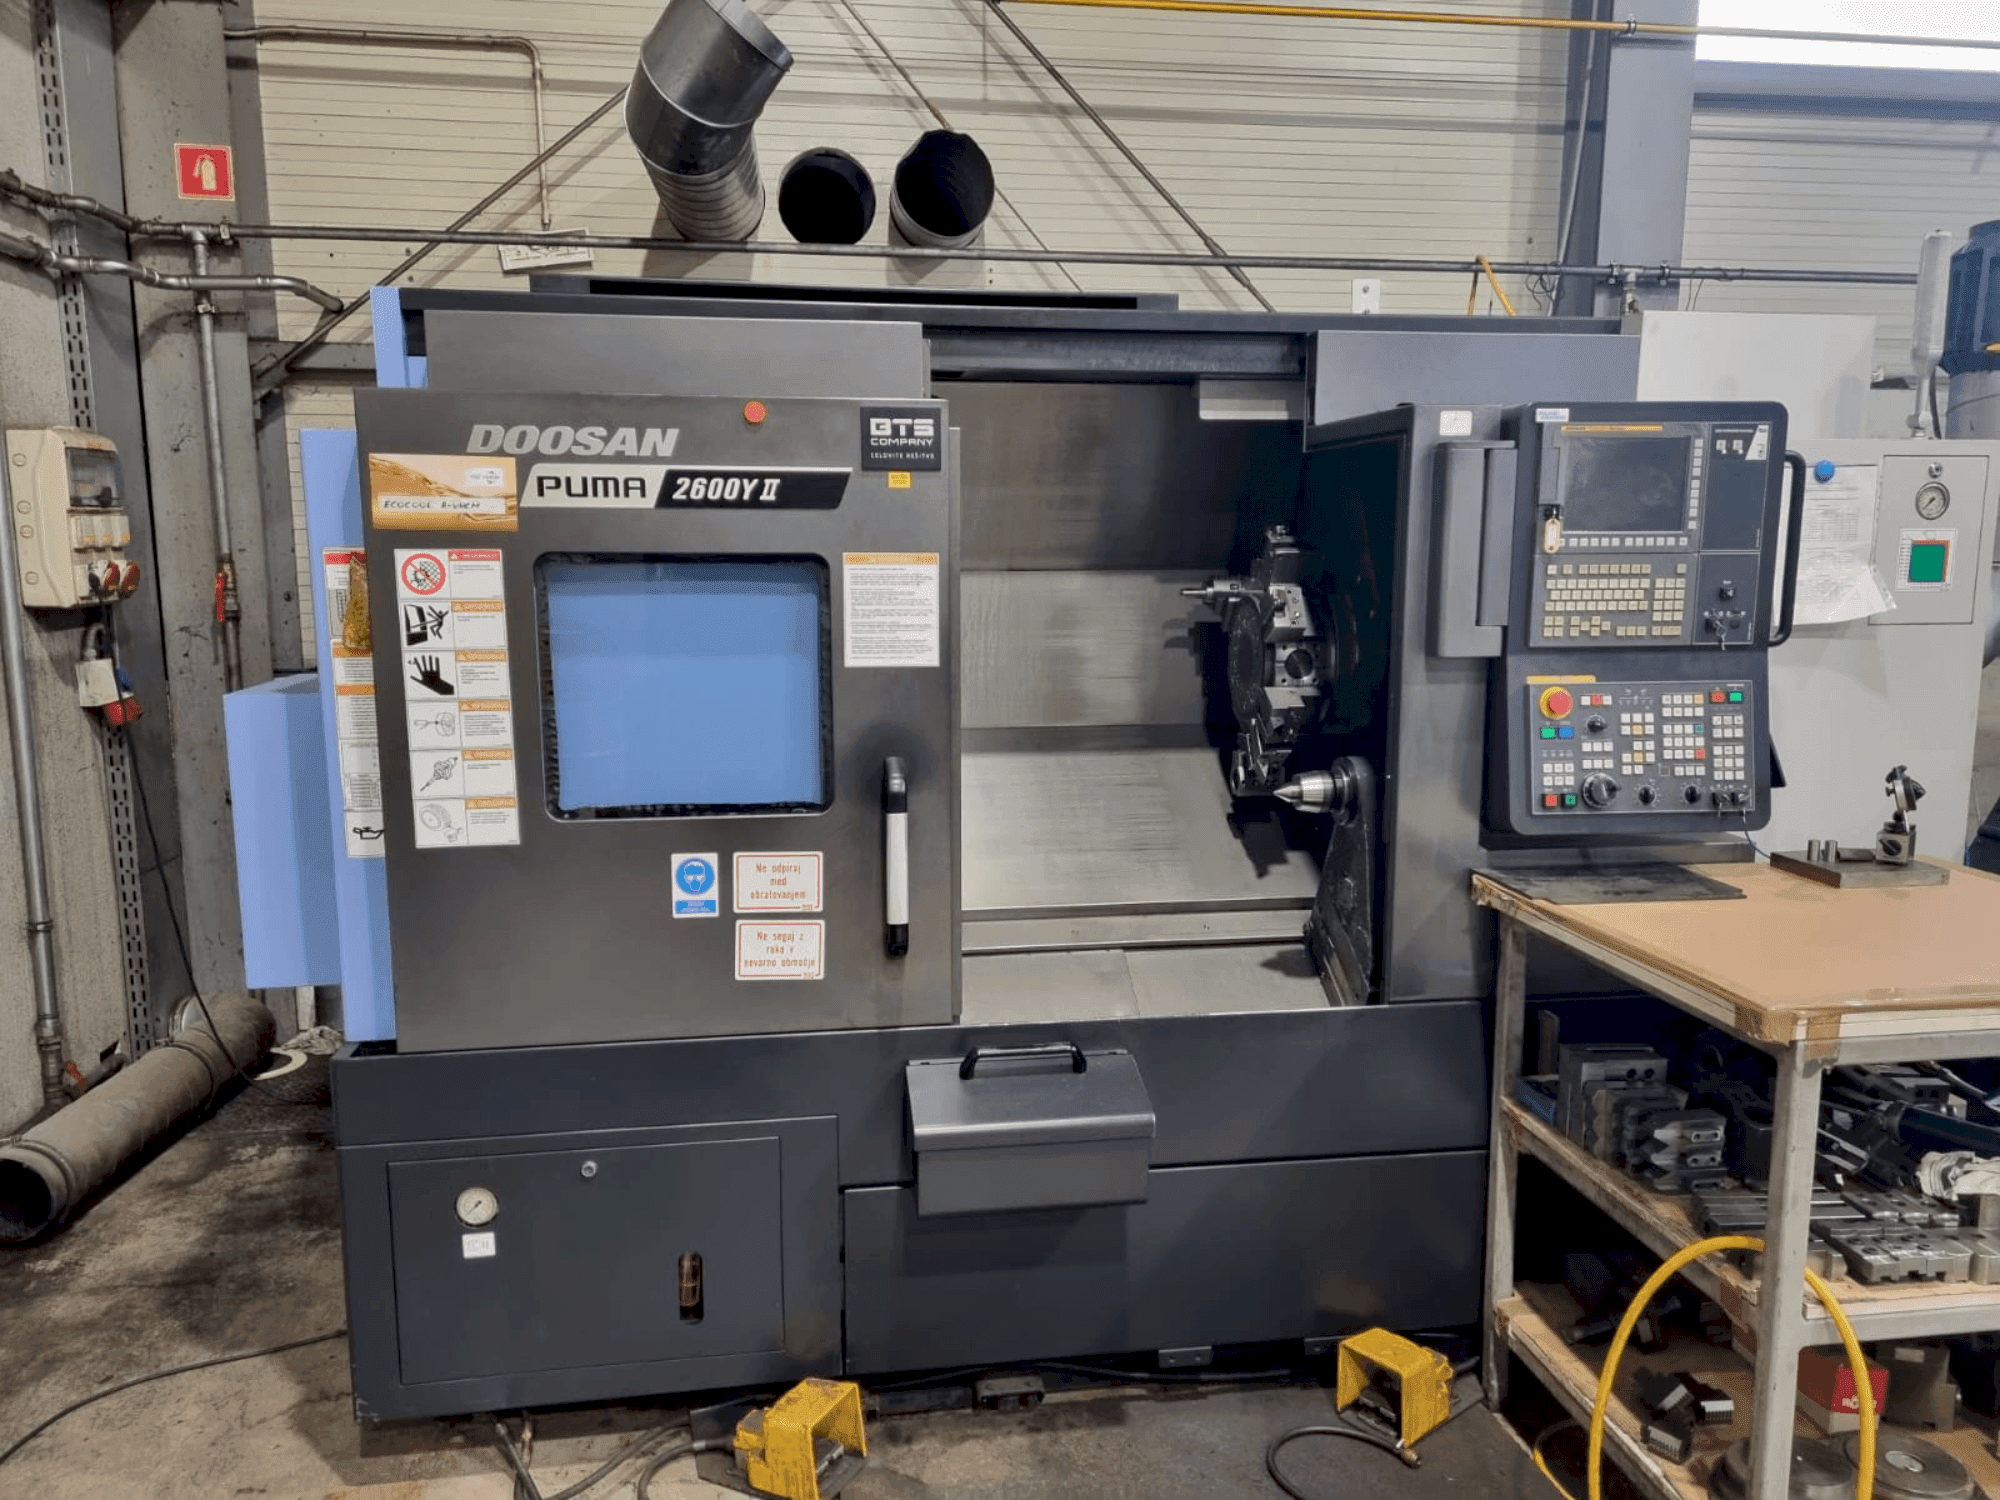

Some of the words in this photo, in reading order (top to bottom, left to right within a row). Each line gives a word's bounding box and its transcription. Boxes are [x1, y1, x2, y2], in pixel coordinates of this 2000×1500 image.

[869, 417, 934, 436] BTS
[466, 424, 680, 457] DOOSAN
[870, 438, 933, 447] COMPANY
[536, 475, 647, 498] PUMA
[671, 476, 760, 501] 2600Y
